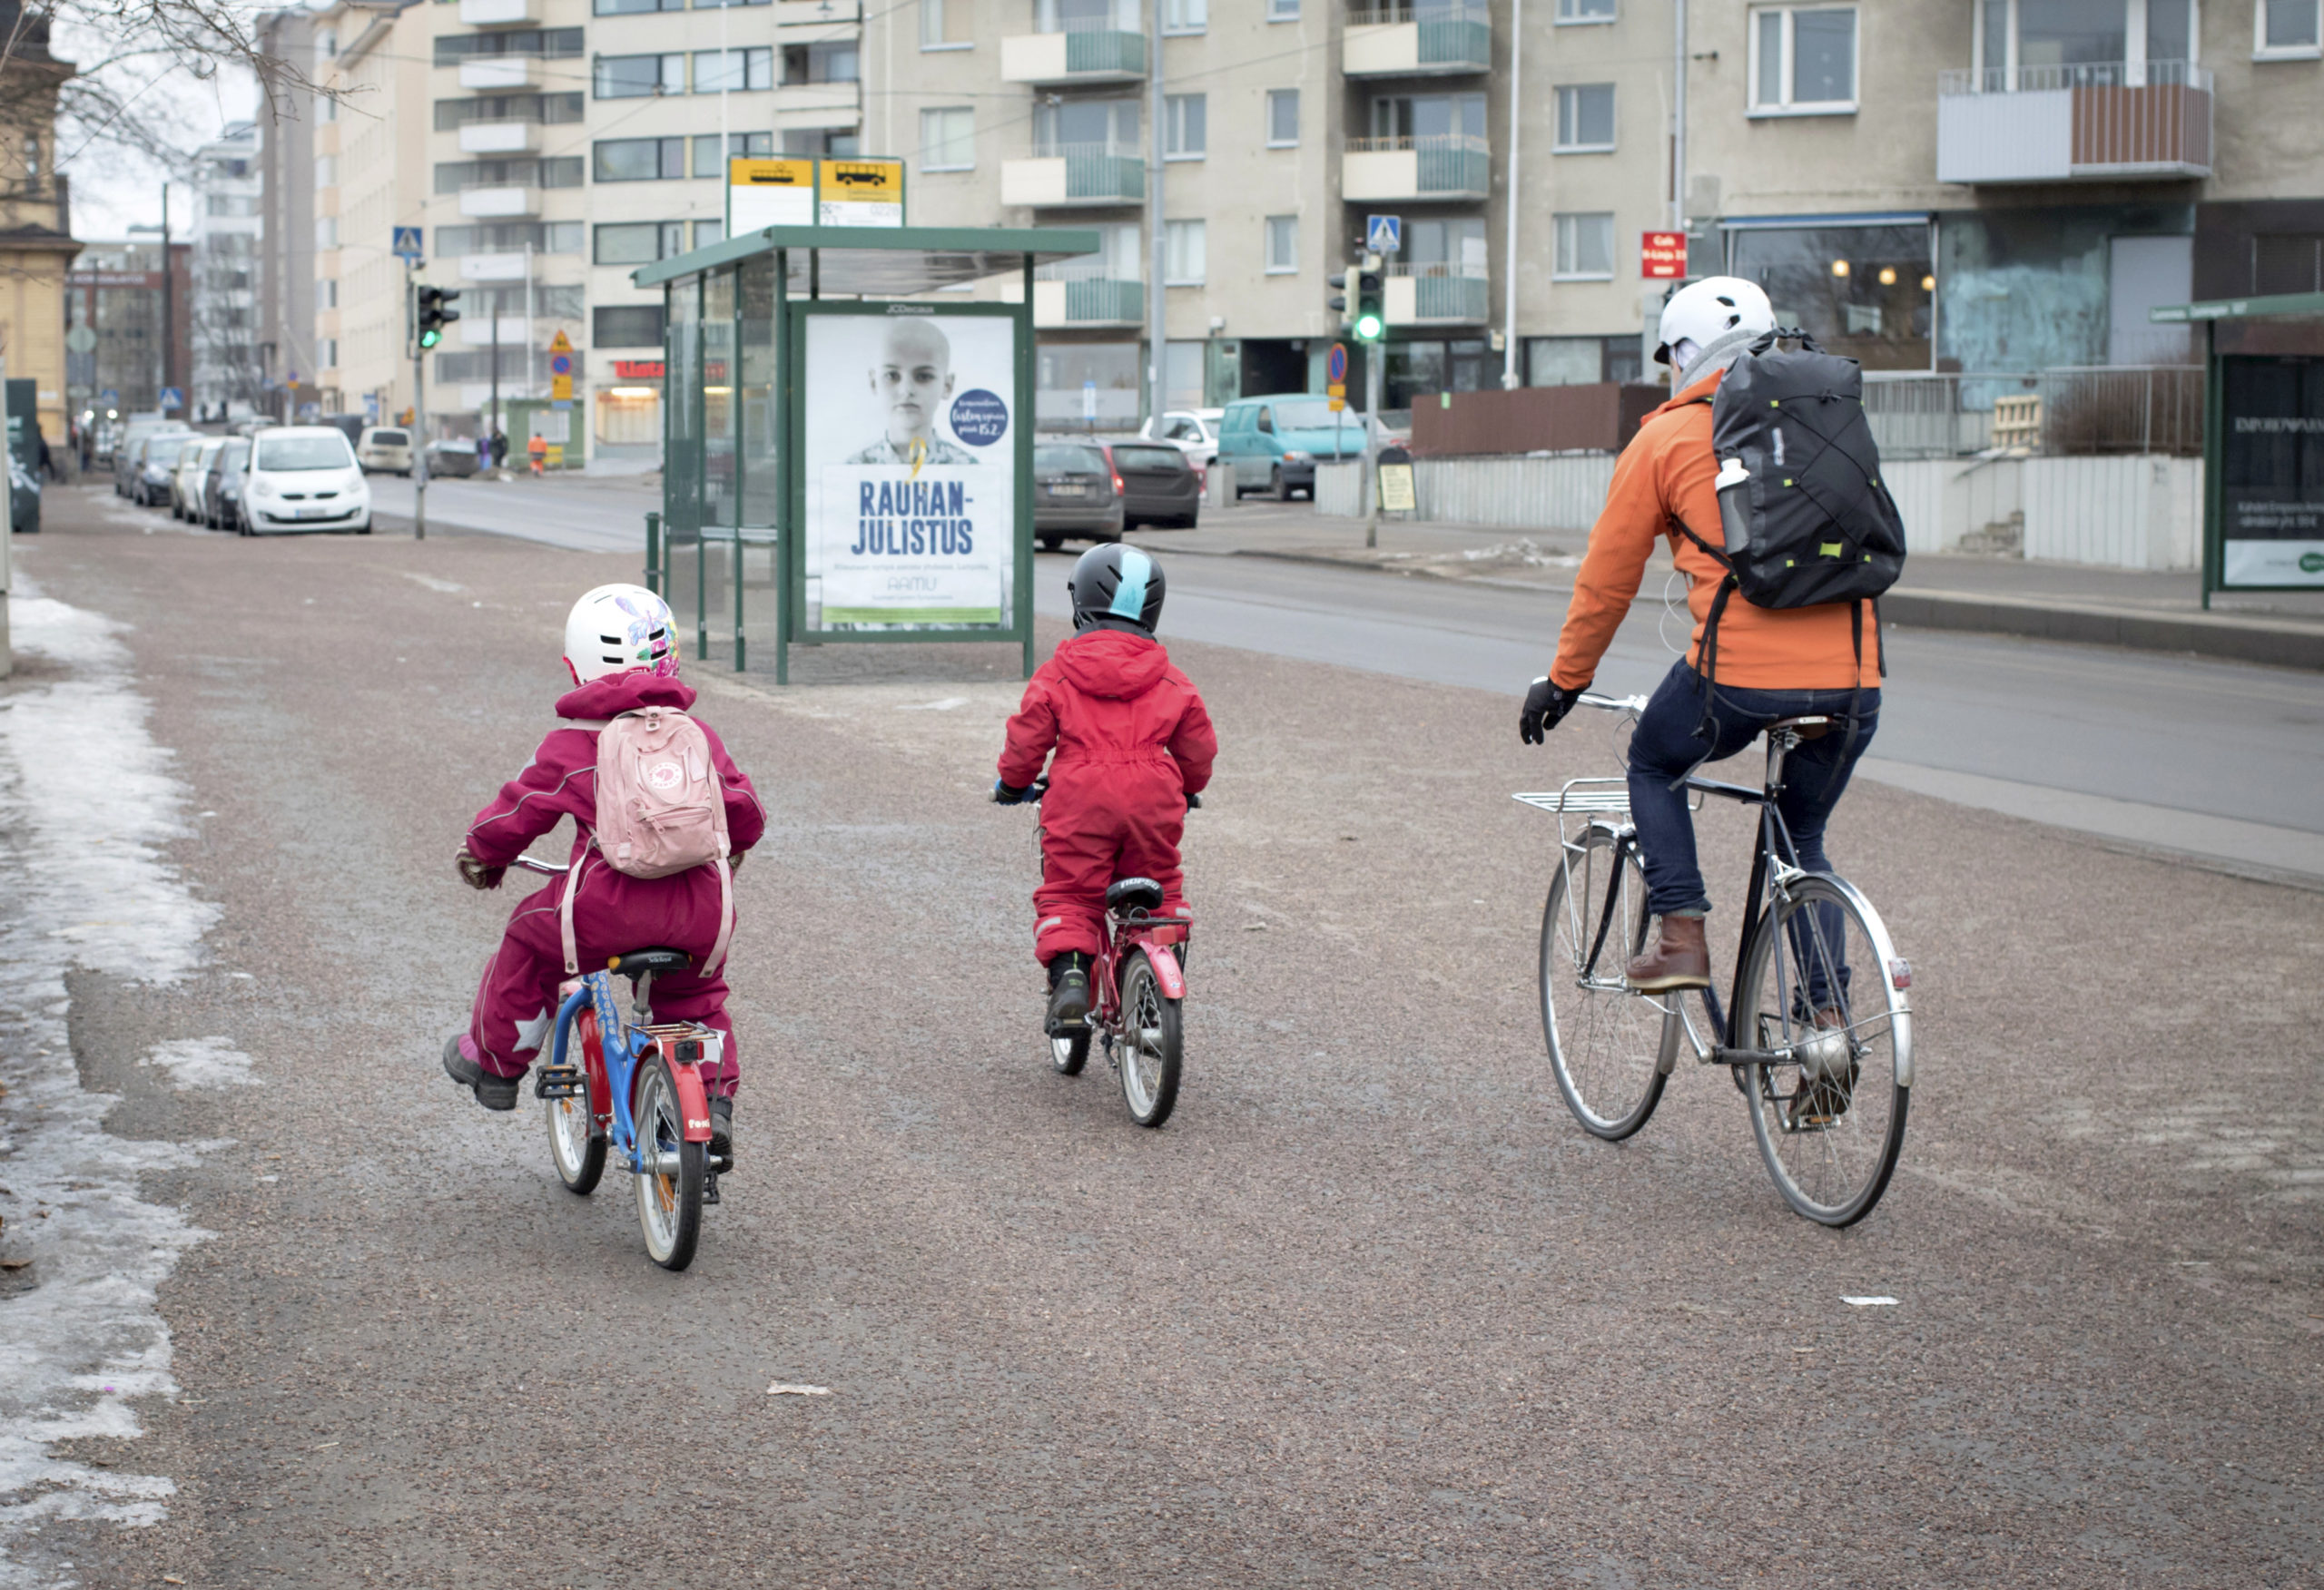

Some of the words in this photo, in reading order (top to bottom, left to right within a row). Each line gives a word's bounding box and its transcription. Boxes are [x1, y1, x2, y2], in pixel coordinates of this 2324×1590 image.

[859, 480, 974, 517] RAUHAN-
[851, 518, 973, 555] JULISTUS
[886, 575, 938, 591] AAMU
